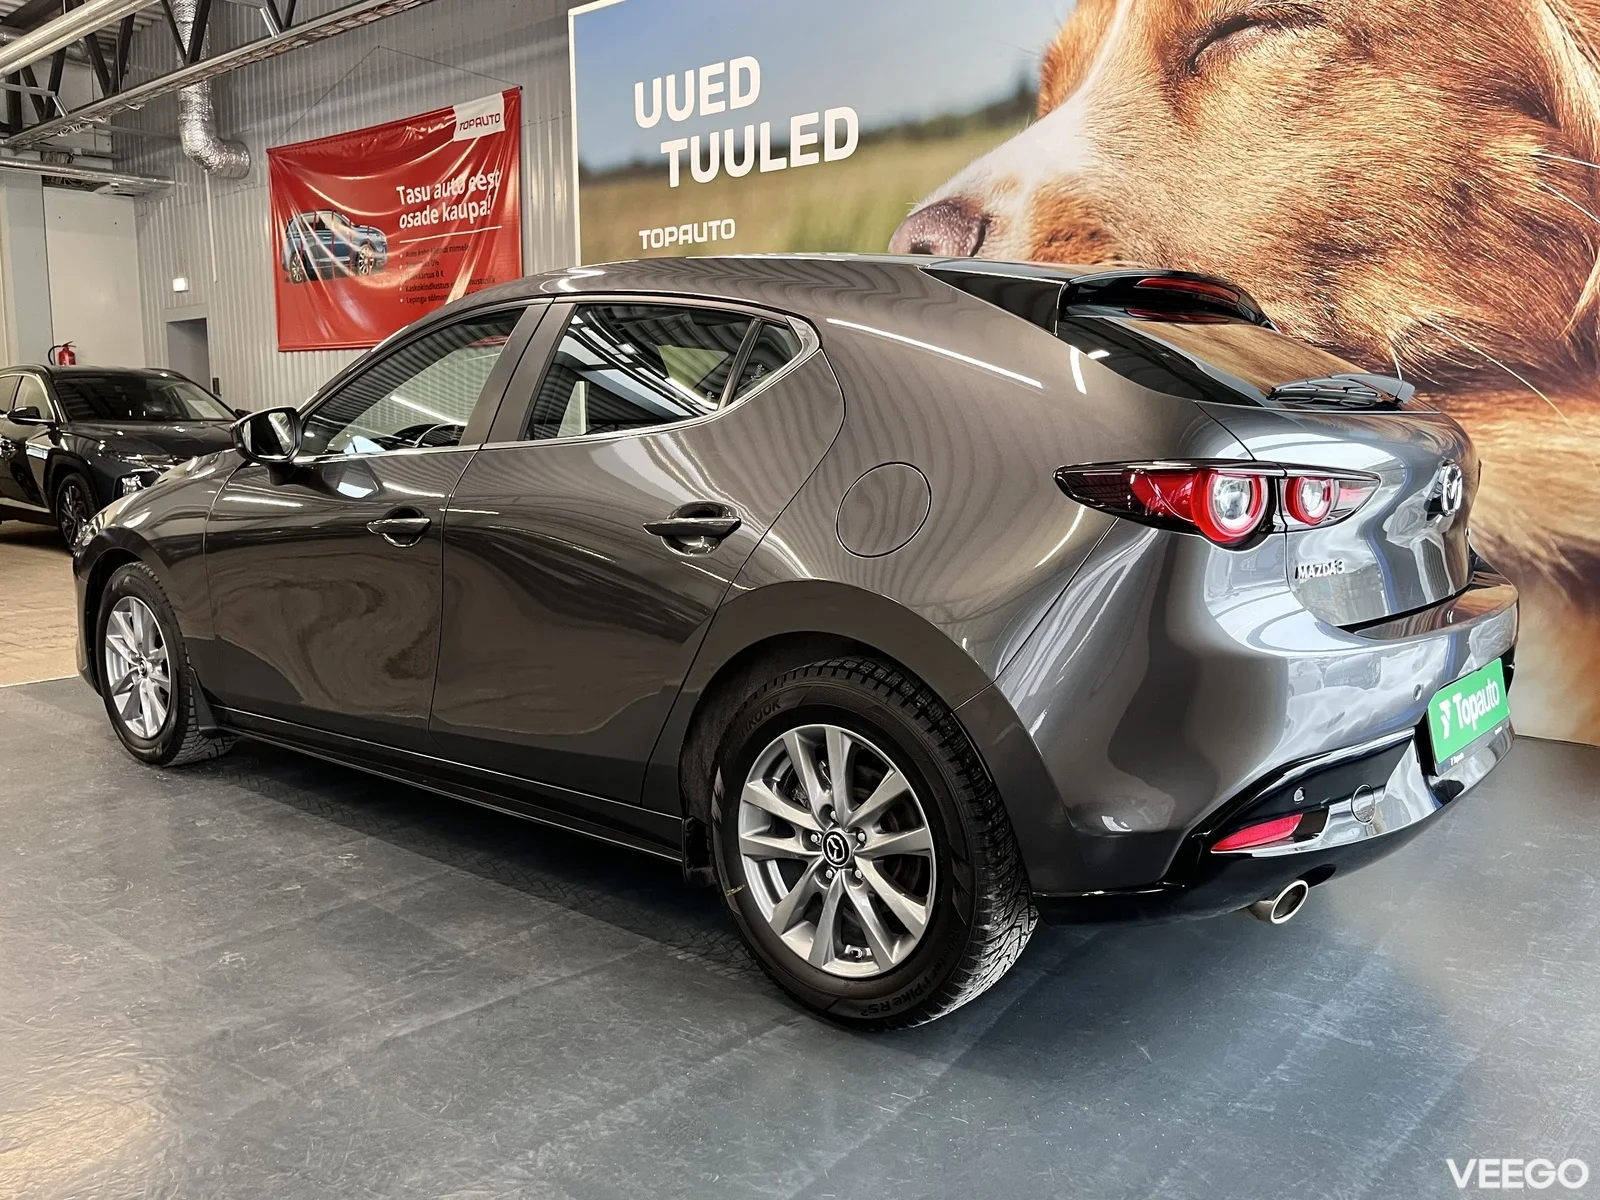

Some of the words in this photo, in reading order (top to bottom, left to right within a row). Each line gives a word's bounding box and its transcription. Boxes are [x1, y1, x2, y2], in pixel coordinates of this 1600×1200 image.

[634, 55, 761, 128] UUED
[459, 112, 501, 131] TOPAUTO
[660, 106, 859, 188] TUULED
[396, 185, 431, 205] Tasu
[433, 178, 466, 199] auto
[468, 169, 500, 192] eest
[399, 204, 440, 229] osade
[442, 194, 492, 225] kaupa!
[638, 218, 736, 250] TOPAUTO
[1295, 558, 1345, 580] MAZDA3
[1452, 678, 1501, 732] Topauto
